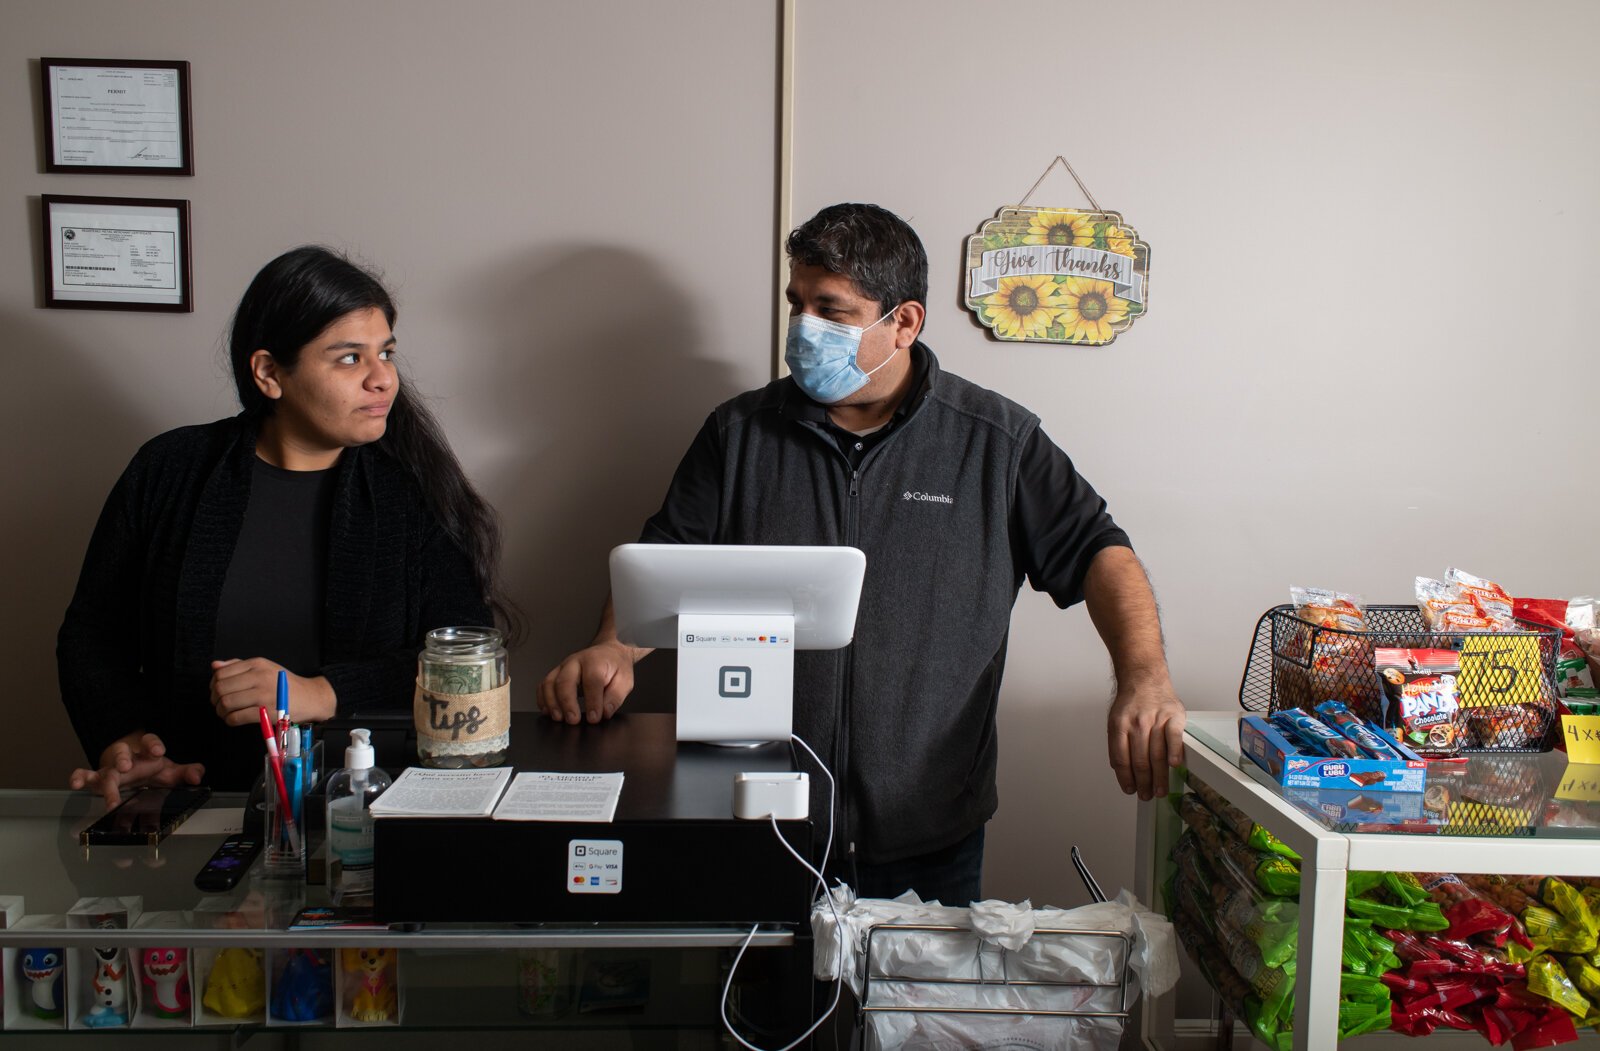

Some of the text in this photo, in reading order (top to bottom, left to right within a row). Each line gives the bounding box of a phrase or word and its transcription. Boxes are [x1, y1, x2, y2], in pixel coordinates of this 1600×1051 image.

[991, 250, 1038, 276] Give
[913, 491, 954, 504] Columbia
[1401, 682, 1432, 698] Hello
[422, 693, 488, 740] Tips
[1414, 713, 1448, 725] Chocolate
[588, 847, 618, 856] Square
